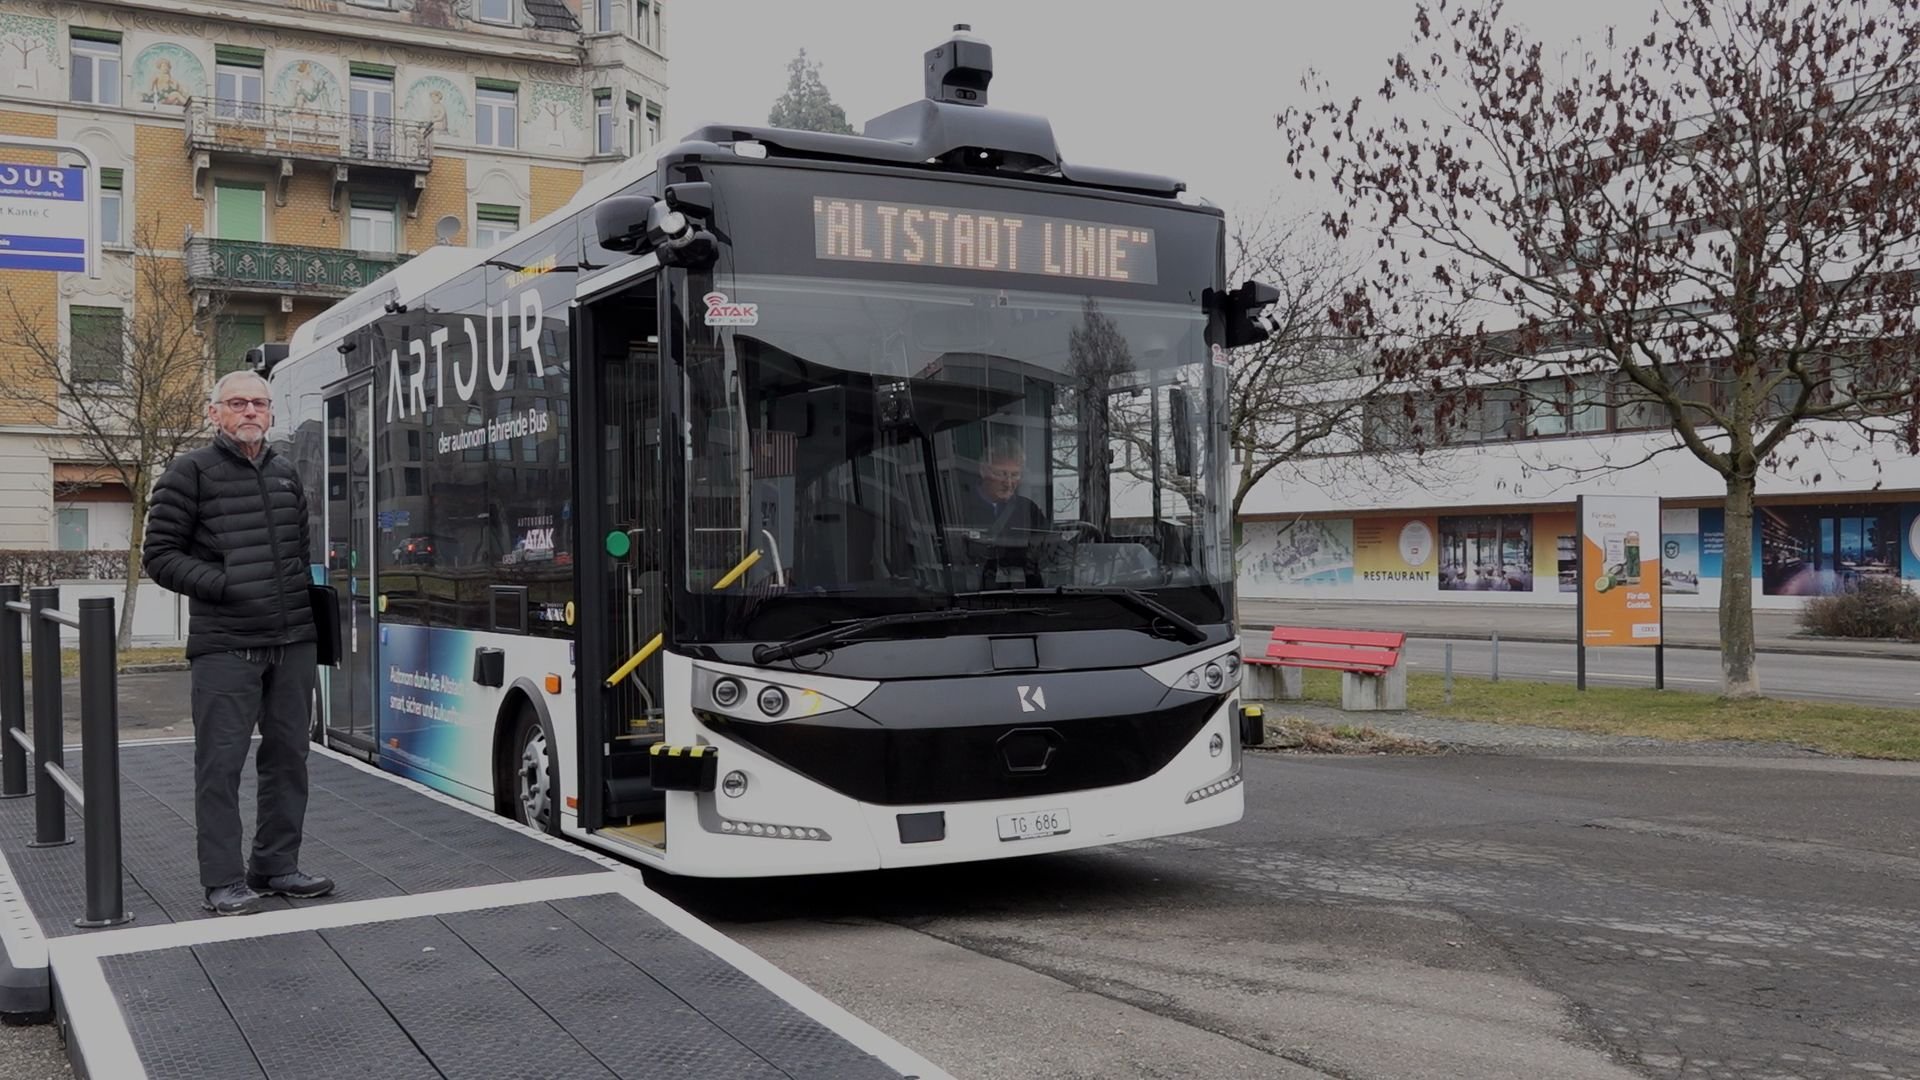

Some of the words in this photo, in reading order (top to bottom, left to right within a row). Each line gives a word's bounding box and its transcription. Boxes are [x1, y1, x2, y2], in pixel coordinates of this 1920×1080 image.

[7, 207, 39, 217] Kante
[709, 306, 753, 317] ATAK
[387, 289, 544, 423] ARTOUR
[439, 432, 451, 455] der
[451, 427, 486, 452] autonom
[488, 411, 528, 444] fahrende
[529, 408, 548, 435] Bus
[524, 528, 555, 550] ATAK
[1363, 571, 1430, 581] RESTAURANT
[414, 670, 430, 690] durch
[430, 673, 441, 692] die
[422, 701, 434, 719] und
[1012, 817, 1027, 833] TG
[1035, 813, 1058, 831] 686
